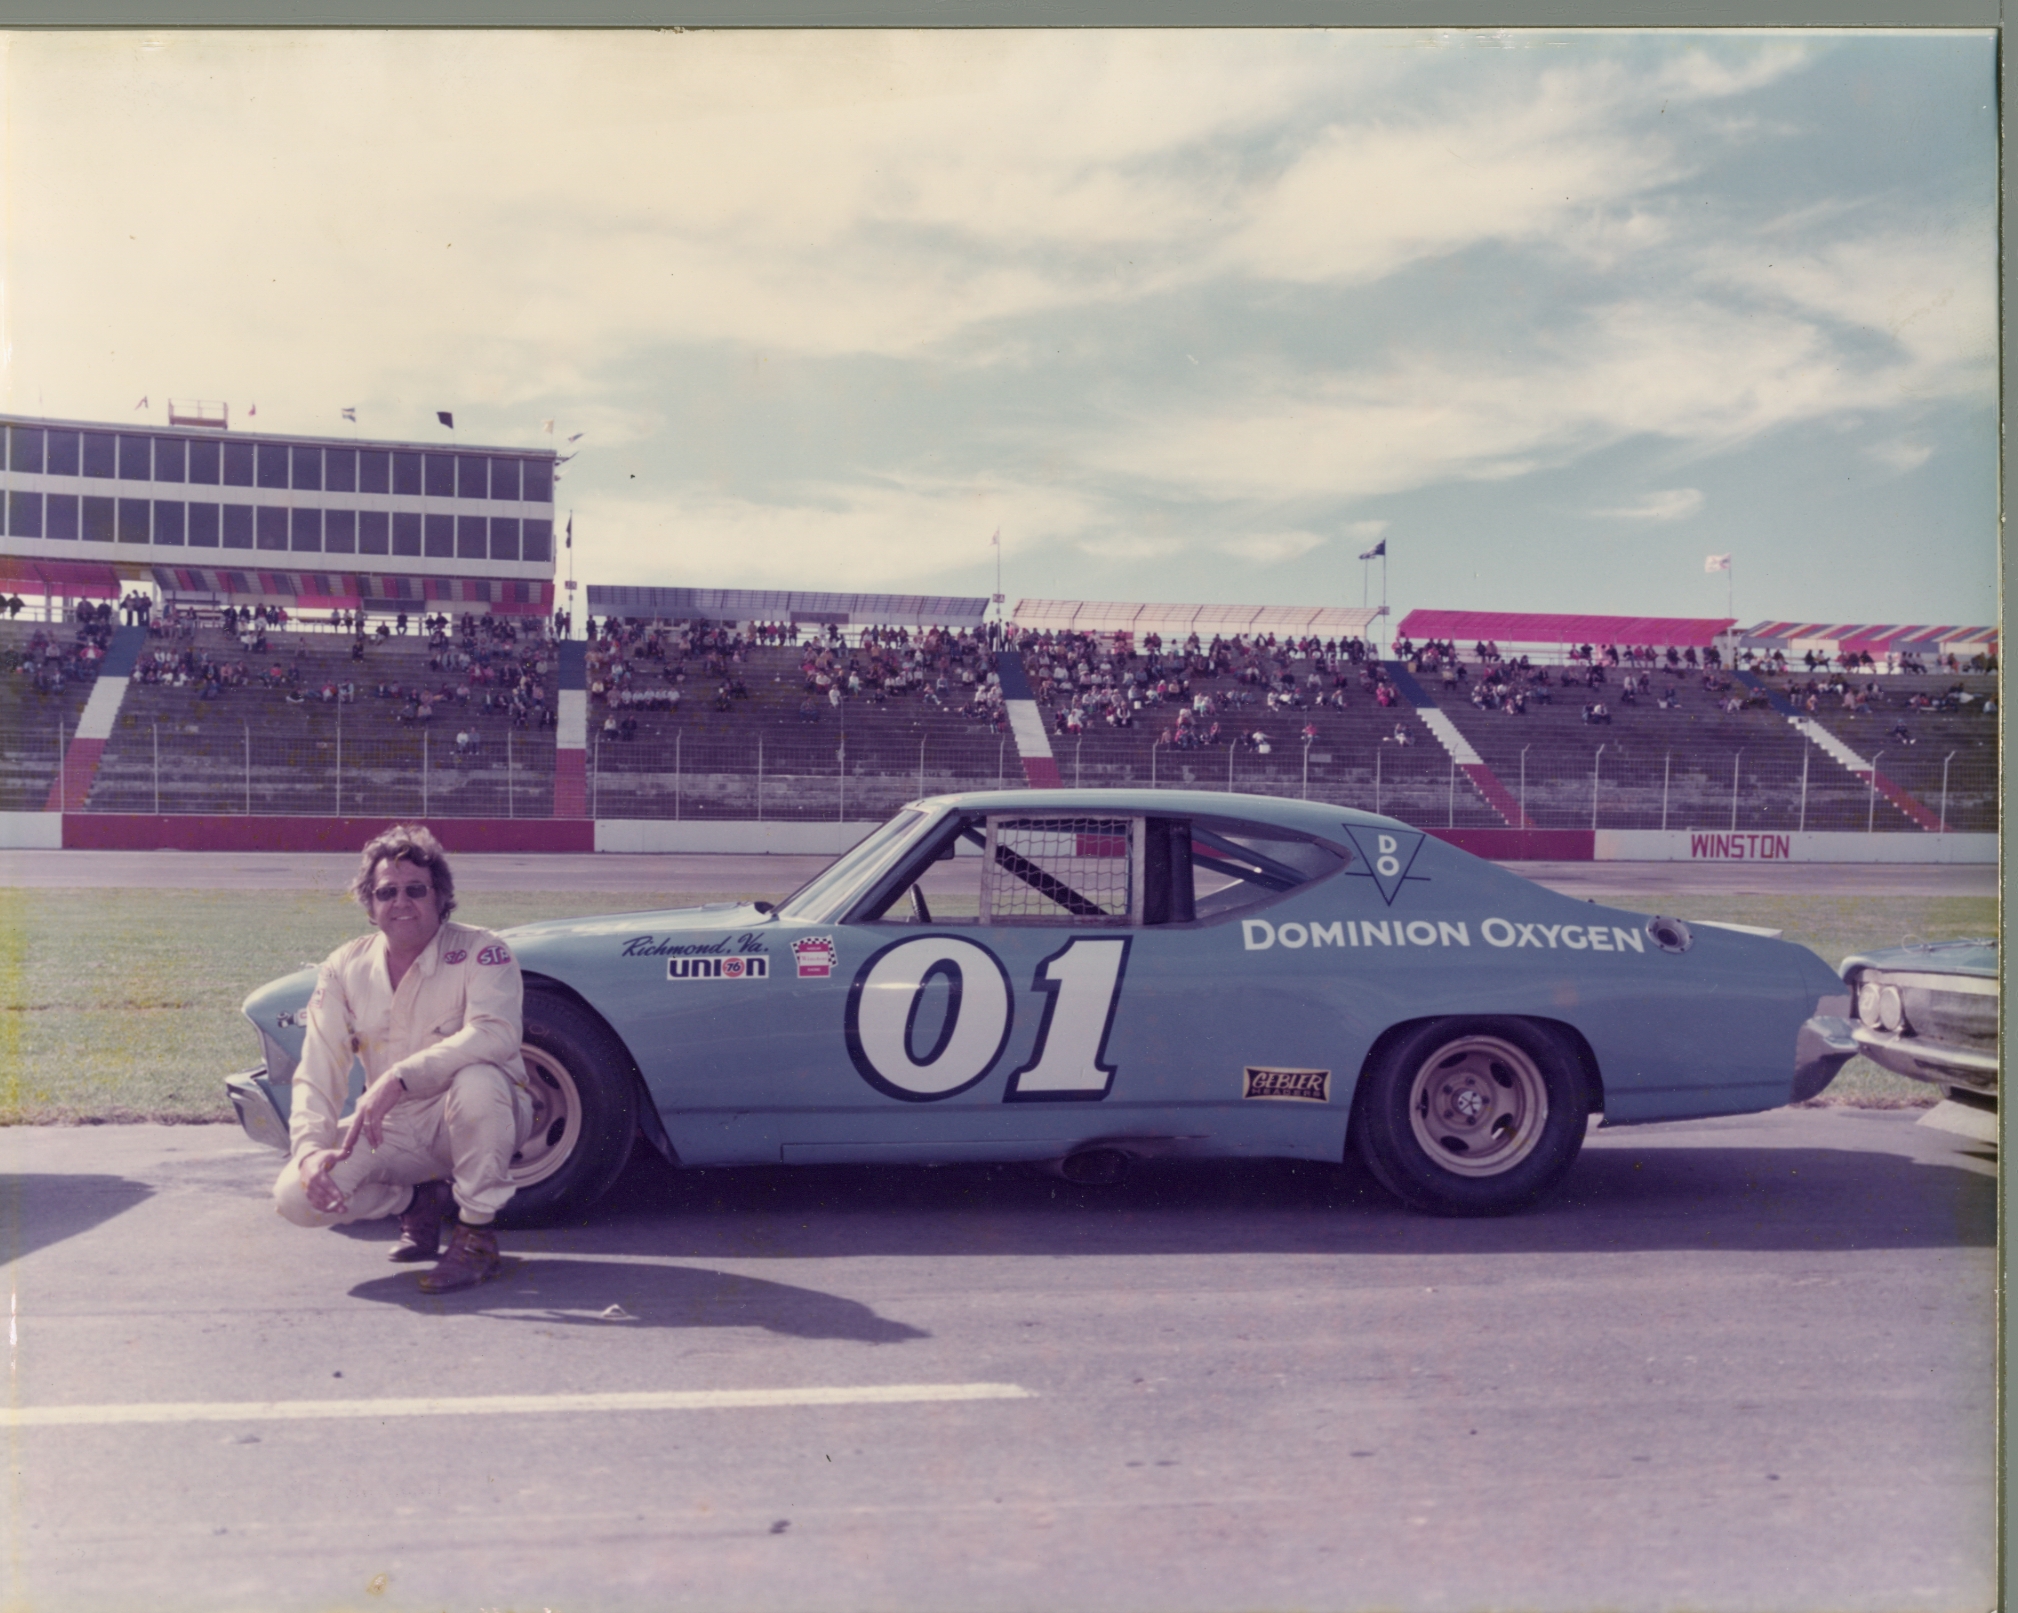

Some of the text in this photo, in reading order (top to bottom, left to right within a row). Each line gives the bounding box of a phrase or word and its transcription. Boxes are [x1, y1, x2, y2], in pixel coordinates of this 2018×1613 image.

[1691, 834, 1790, 859] WINSTON
[737, 932, 769, 953] Va.
[1242, 918, 1645, 953] DOMINION OXYGEN
[480, 946, 509, 965] STP
[726, 961, 741, 972] 76
[844, 933, 1134, 1103] 01
[1252, 1072, 1322, 1091] GEBLER
